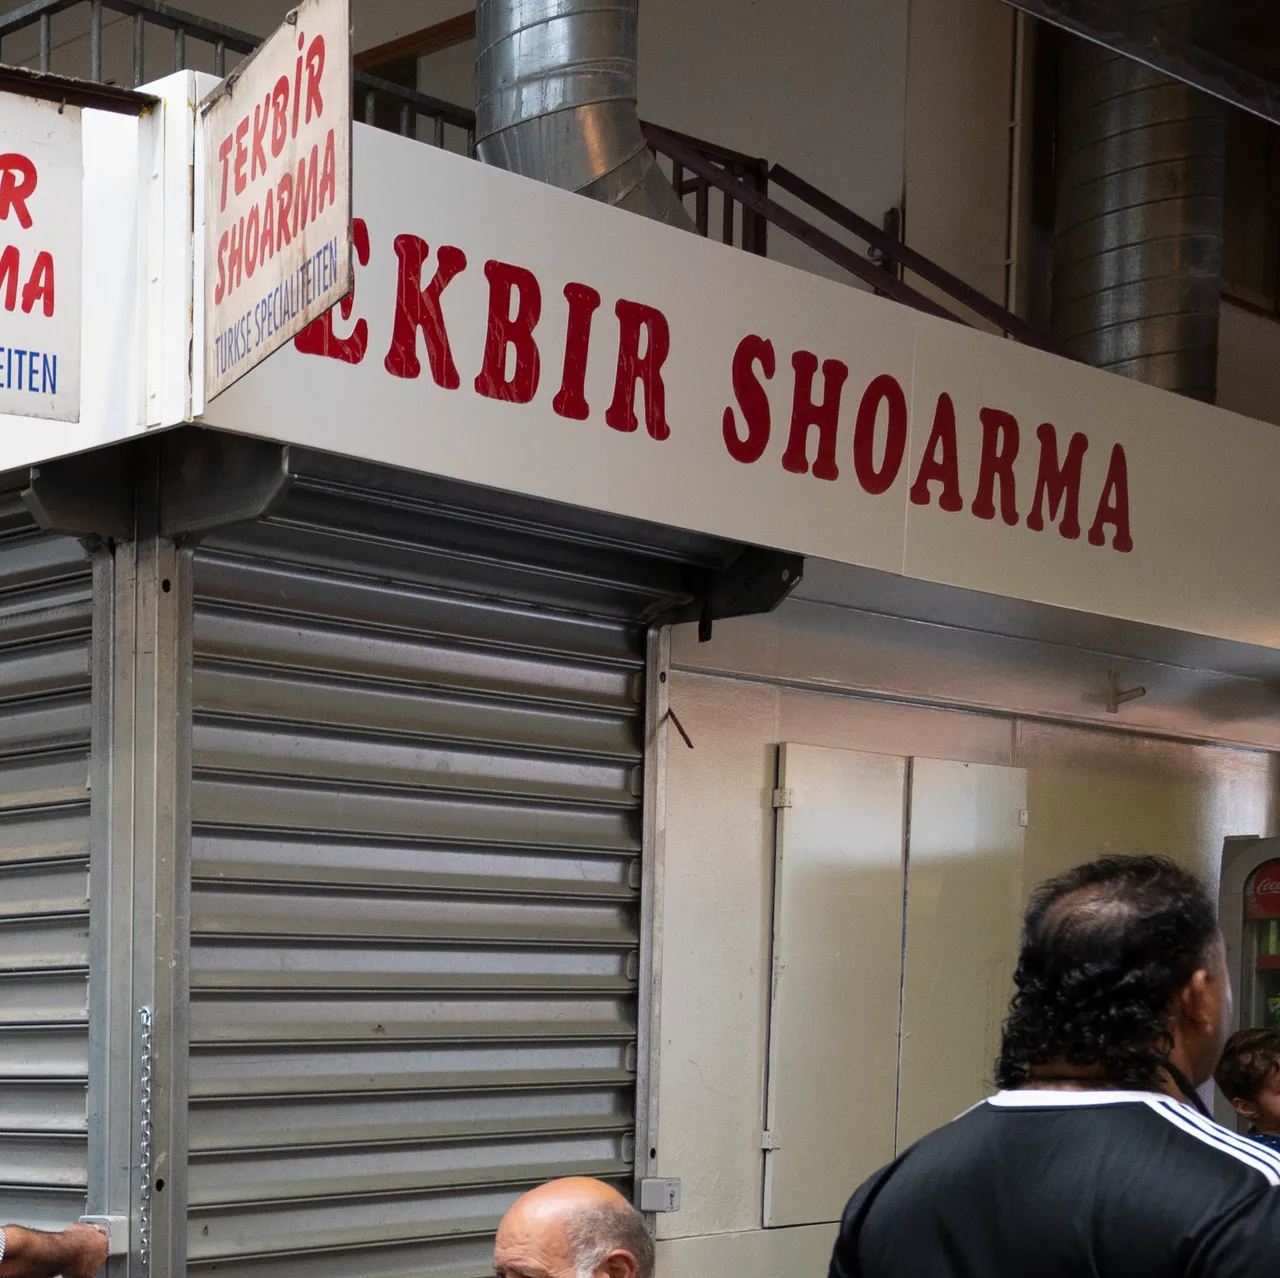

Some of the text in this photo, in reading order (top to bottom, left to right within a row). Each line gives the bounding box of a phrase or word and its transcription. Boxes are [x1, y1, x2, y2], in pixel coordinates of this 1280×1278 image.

[214, 128, 336, 306] SHOARMA
[214, 236, 339, 379] TURKSE SPECIALITEITEN
[292, 217, 1134, 553] EKBIR SHOARMA
